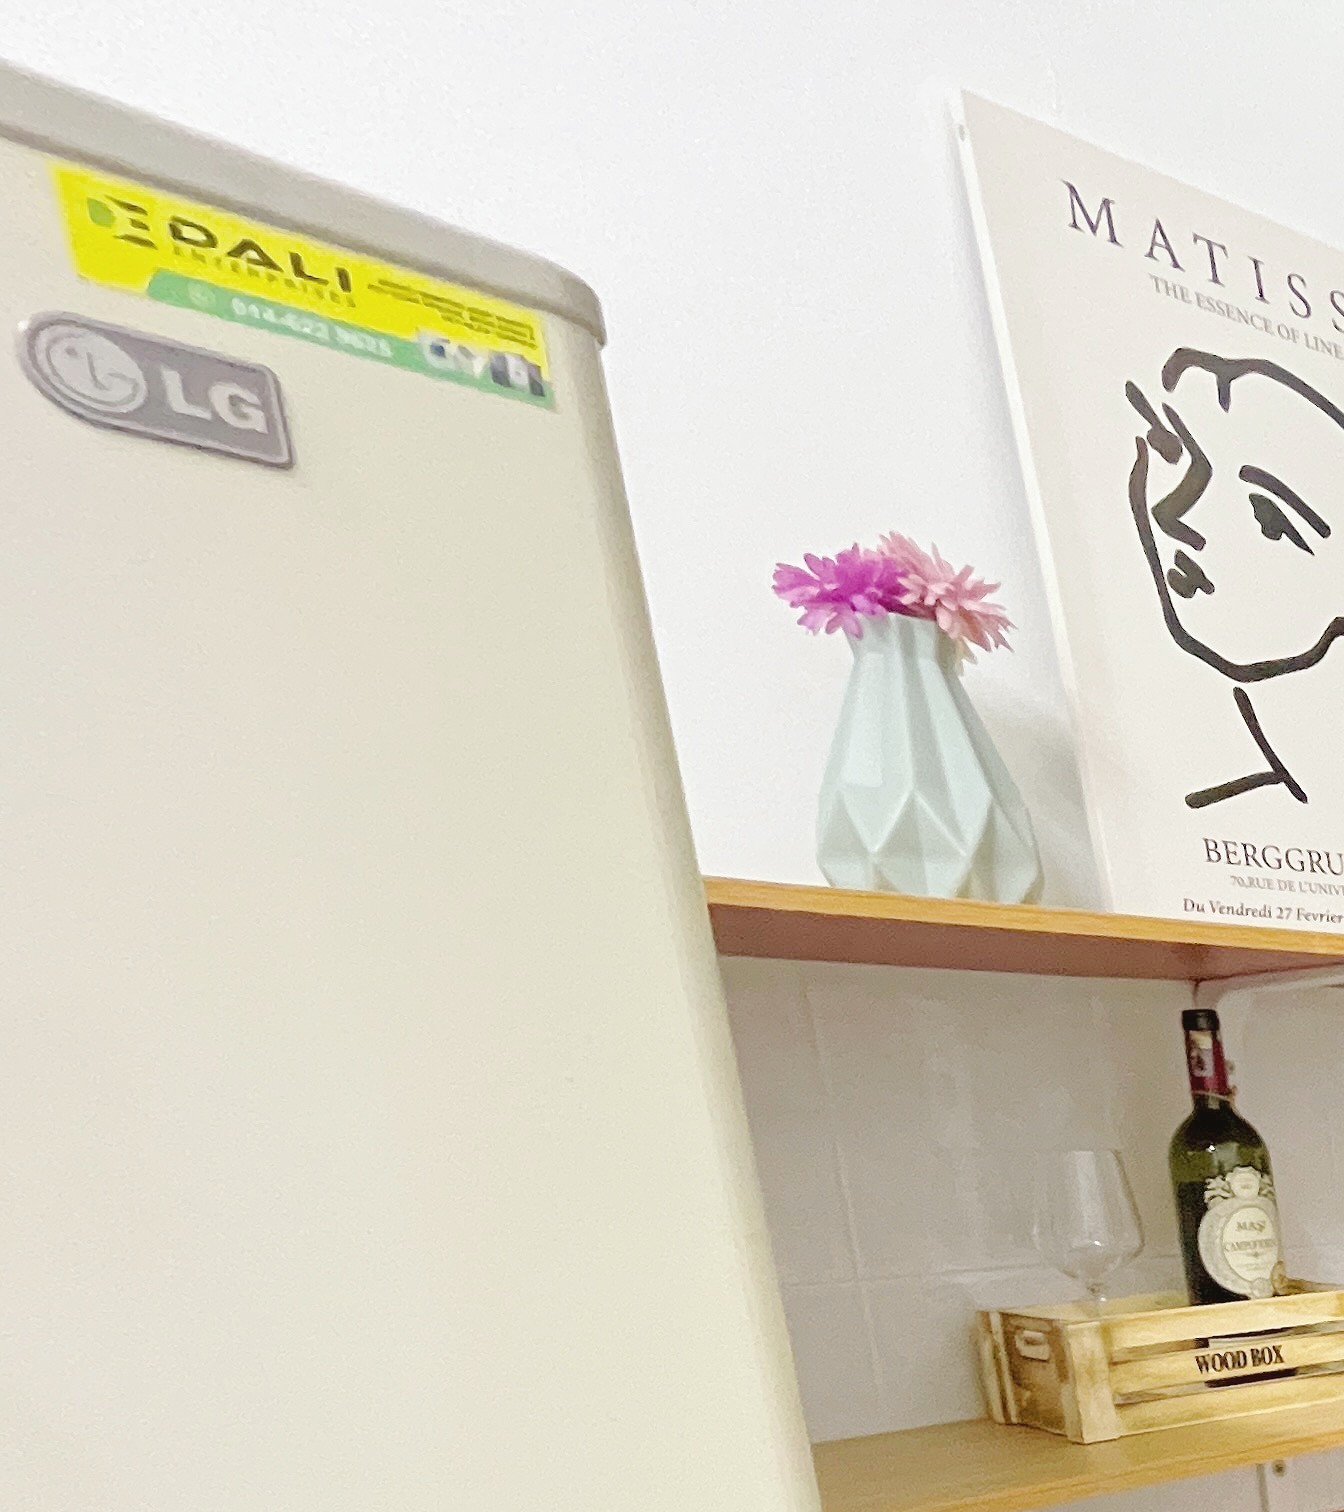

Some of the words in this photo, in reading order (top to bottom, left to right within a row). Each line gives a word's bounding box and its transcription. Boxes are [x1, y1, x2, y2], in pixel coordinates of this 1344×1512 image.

[1149, 273, 1191, 305] THE
[1194, 291, 1275, 336] ESSENCE
[1277, 322, 1302, 344] OF
[160, 362, 269, 435] LG
[1277, 879, 1297, 892] DE
[1183, 898, 1205, 914] Du
[1208, 899, 1272, 919] Vendredi
[1276, 906, 1292, 920] 27
[1296, 907, 1344, 924] Fevrier
[1194, 1350, 1248, 1375] WOOD
[1250, 1344, 1285, 1367] BOX
